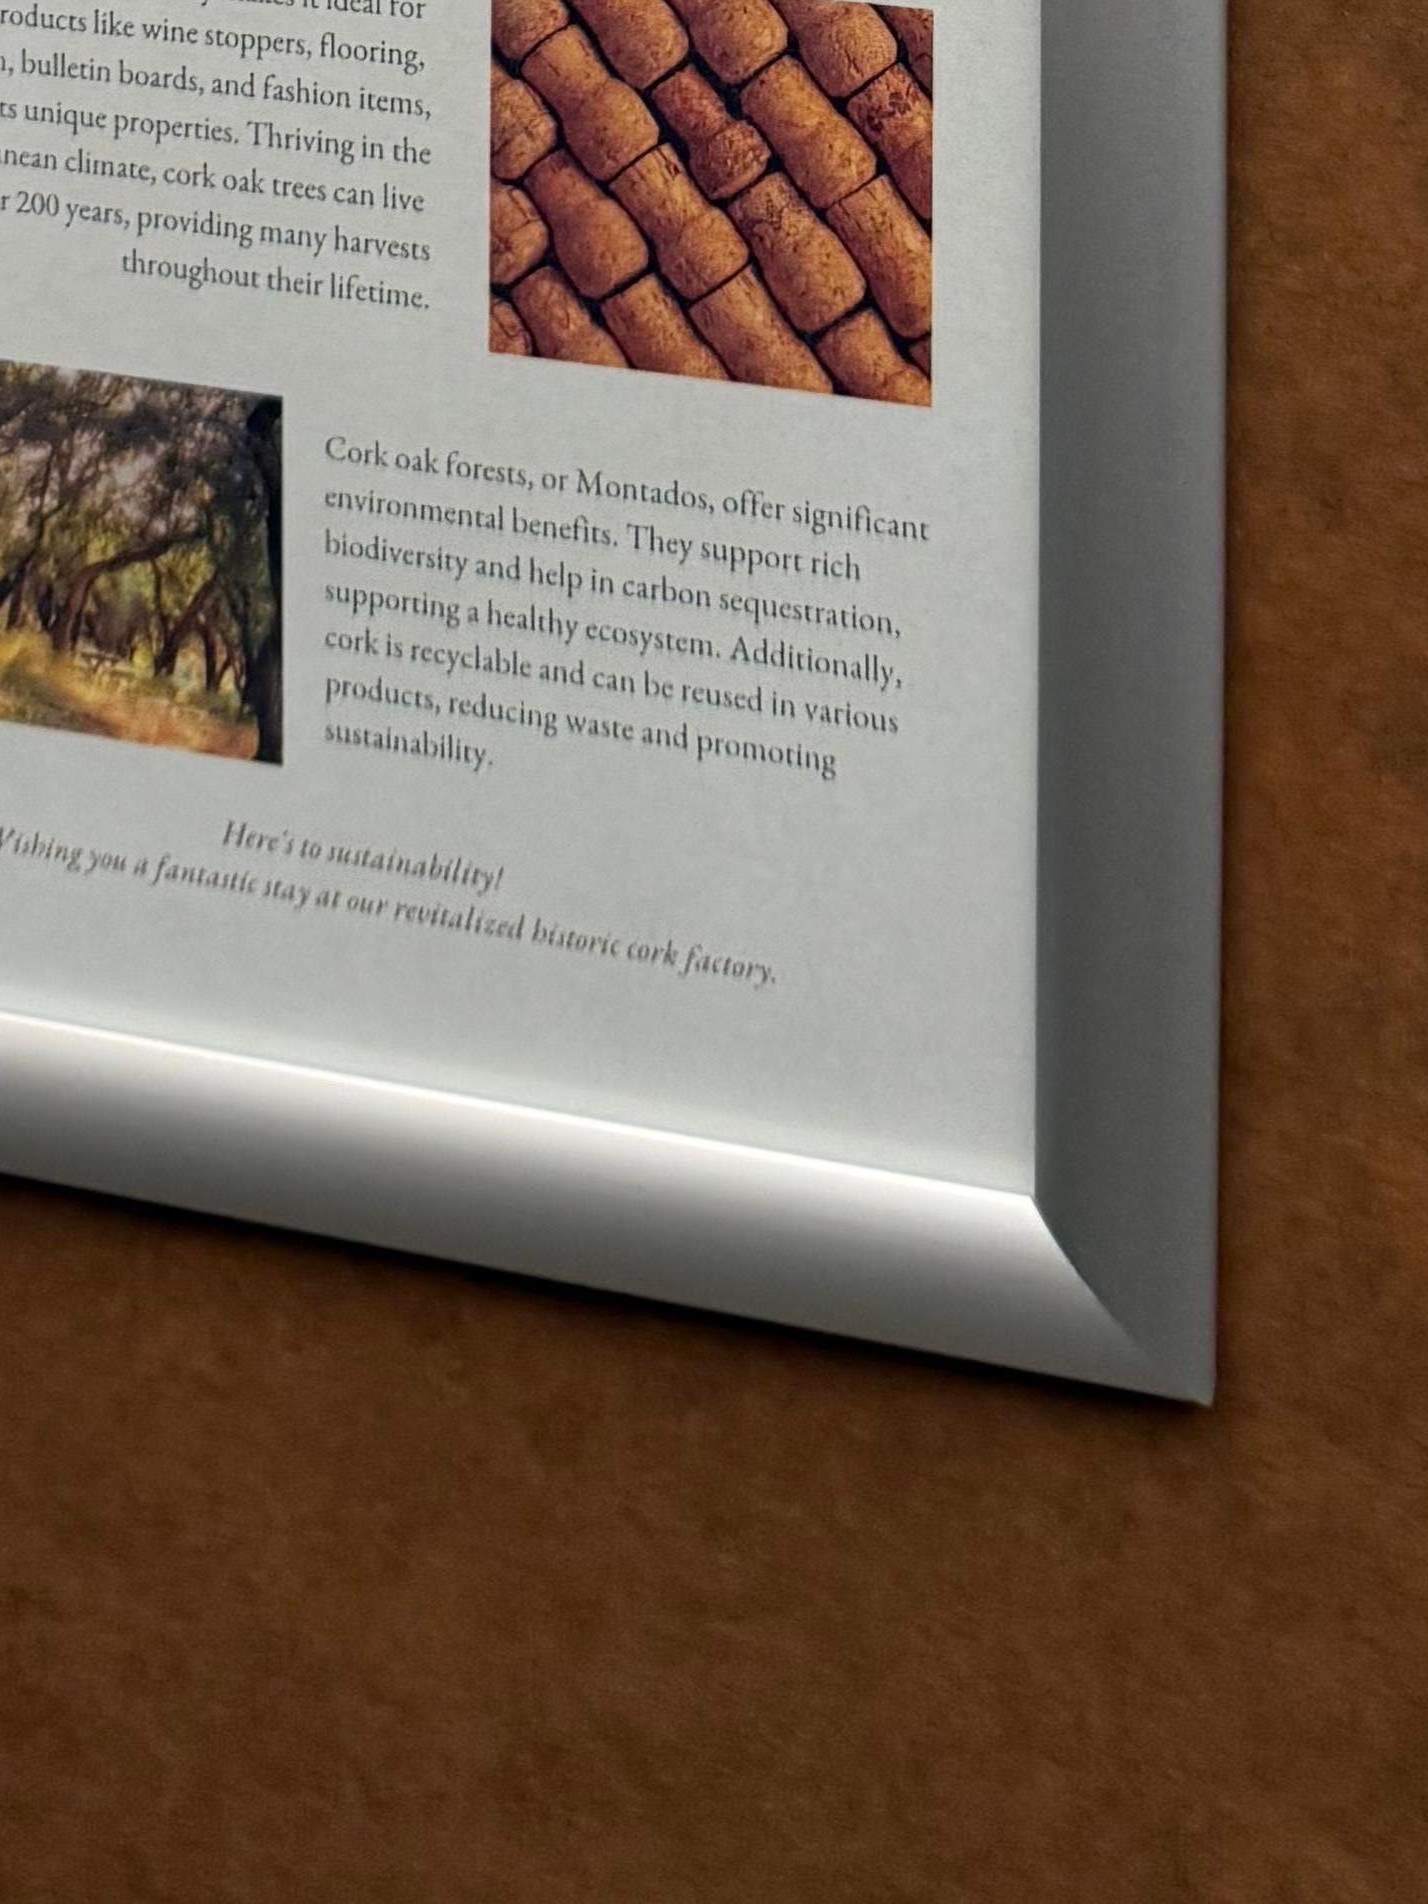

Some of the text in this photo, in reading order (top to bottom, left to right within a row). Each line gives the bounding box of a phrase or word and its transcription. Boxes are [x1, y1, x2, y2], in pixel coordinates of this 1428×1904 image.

[21, 48, 111, 83] bulletin
[119, 59, 204, 96] boards,
[211, 72, 255, 99] and
[263, 74, 351, 109] fashion
[359, 86, 431, 121] items,
[325, 436, 928, 541] Cork oak forests, or Montados, offer significant
[325, 490, 860, 582] environmental benefits. They support rich
[325, 725, 493, 773] sustainability.
[223, 820, 504, 897] Here's to sustainability!
